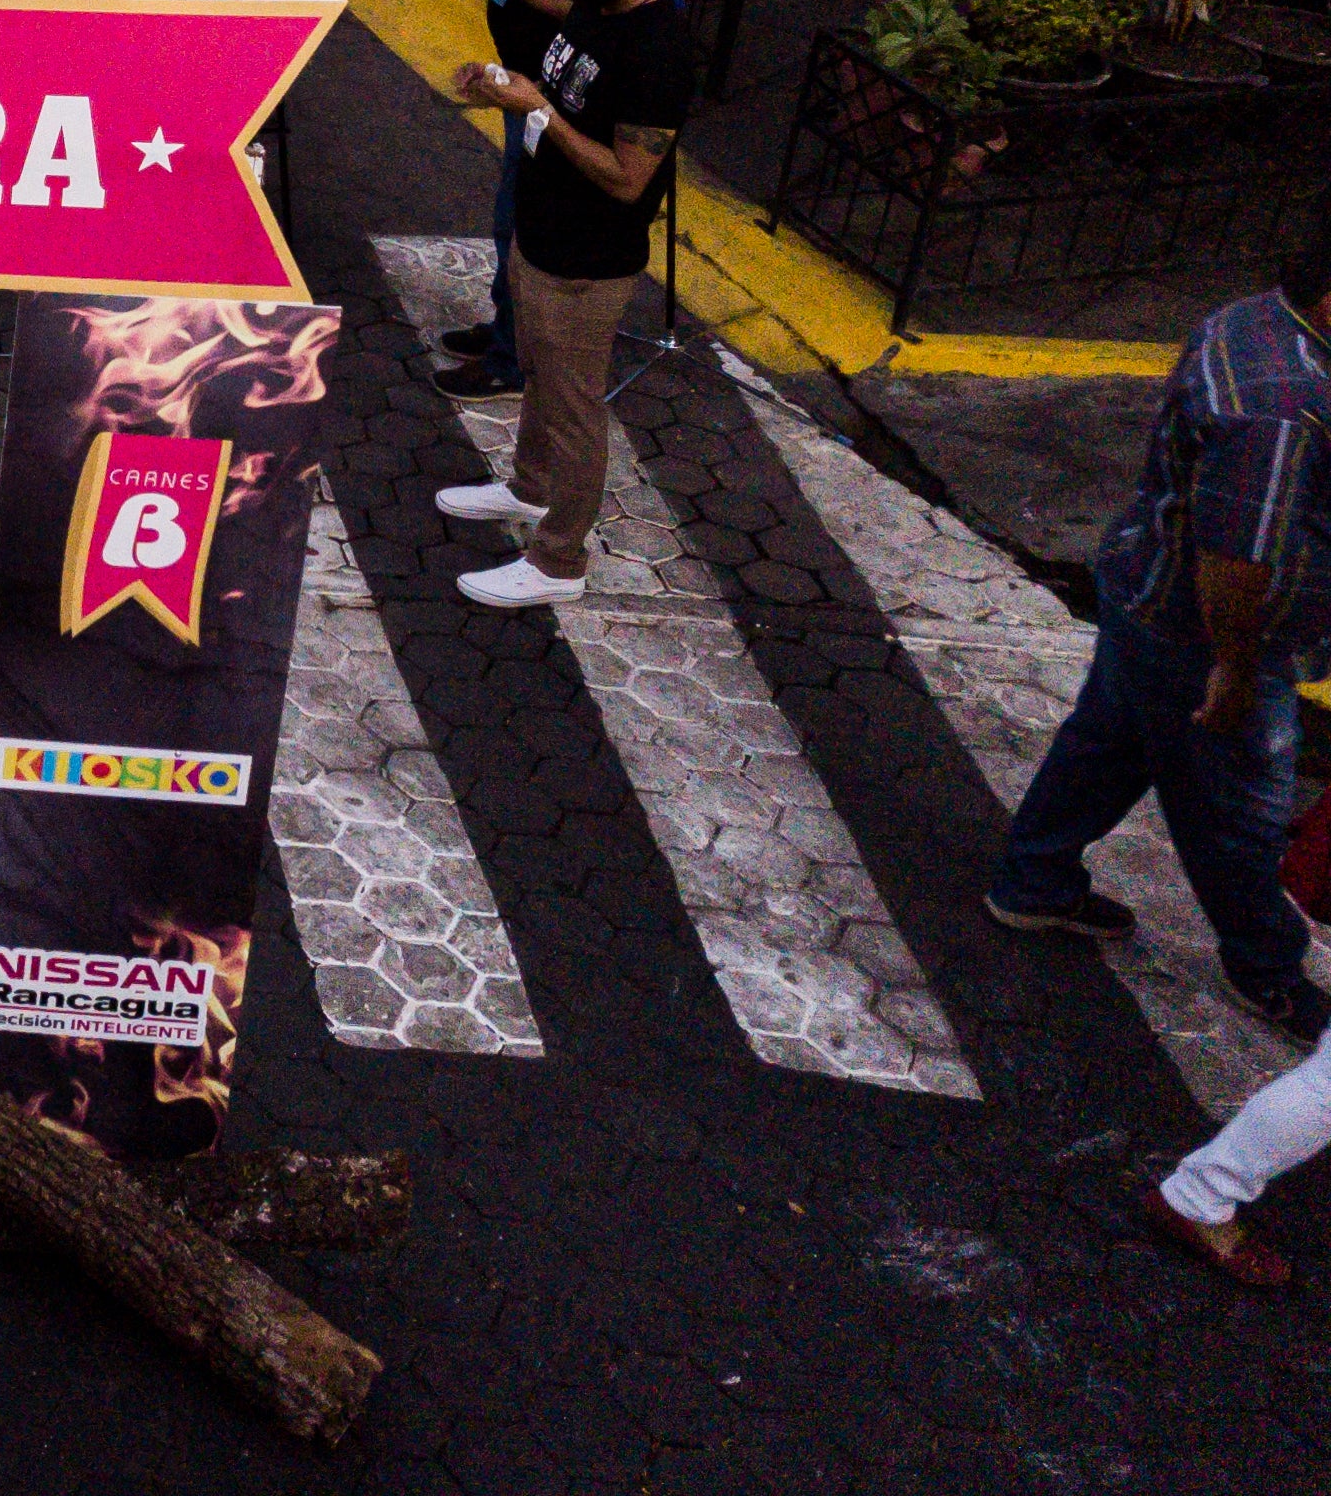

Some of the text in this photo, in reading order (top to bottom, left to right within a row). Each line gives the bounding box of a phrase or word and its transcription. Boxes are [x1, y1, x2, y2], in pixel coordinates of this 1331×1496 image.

[108, 467, 210, 491] CARNES
[3, 746, 242, 797] KIOSKO
[70, 1018, 198, 1041] INTELIGENTE
